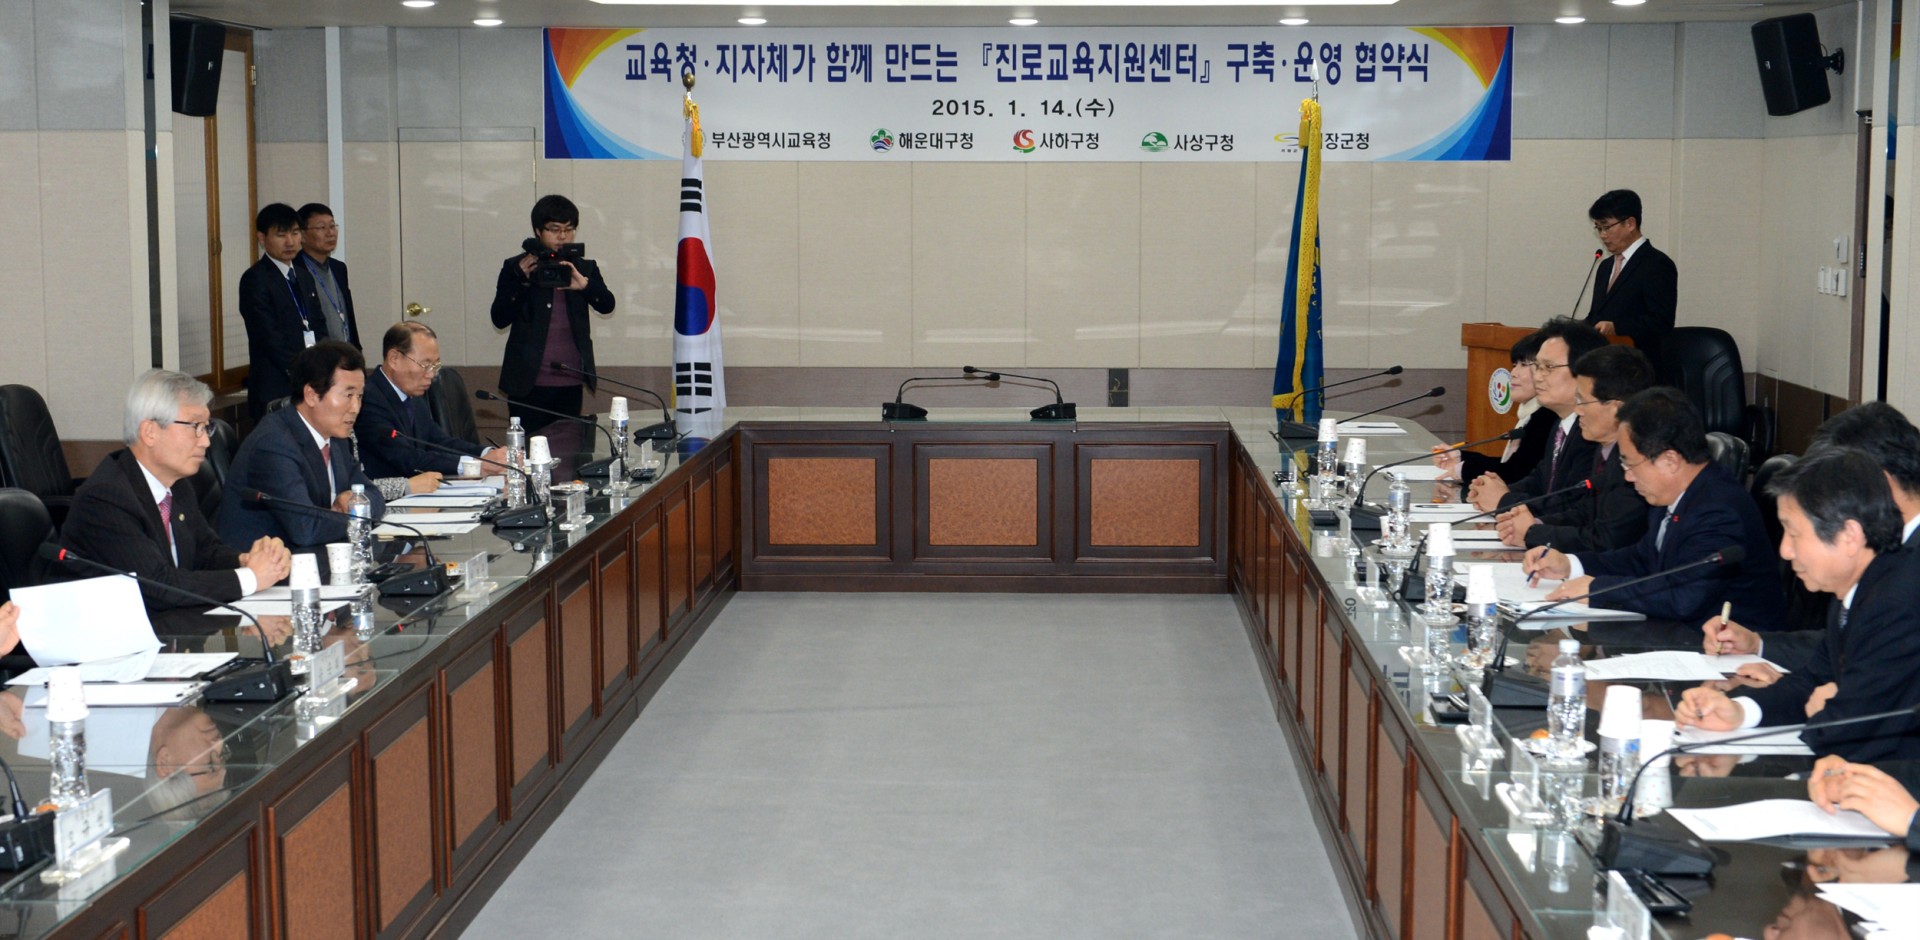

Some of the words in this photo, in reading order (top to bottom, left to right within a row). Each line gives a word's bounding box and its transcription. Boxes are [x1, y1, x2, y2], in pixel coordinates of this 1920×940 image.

[625, 42, 816, 84] 교육청·지자체가
[826, 41, 873, 83] 함께
[885, 43, 958, 83] 만드는
[982, 42, 1210, 84] 『진로교육지원센터』
[1226, 41, 1342, 86] 구축·운영
[1354, 41, 1429, 83] 협약식
[932, 99, 993, 117] 2015.
[1008, 99, 1026, 117] 1.
[1040, 98, 1115, 118] 14.(수)
[711, 132, 831, 150] 부산광역시교육청
[898, 132, 973, 150] 해운대구청
[1039, 132, 1099, 150] 사하구청
[1173, 134, 1234, 152] 사상구청
